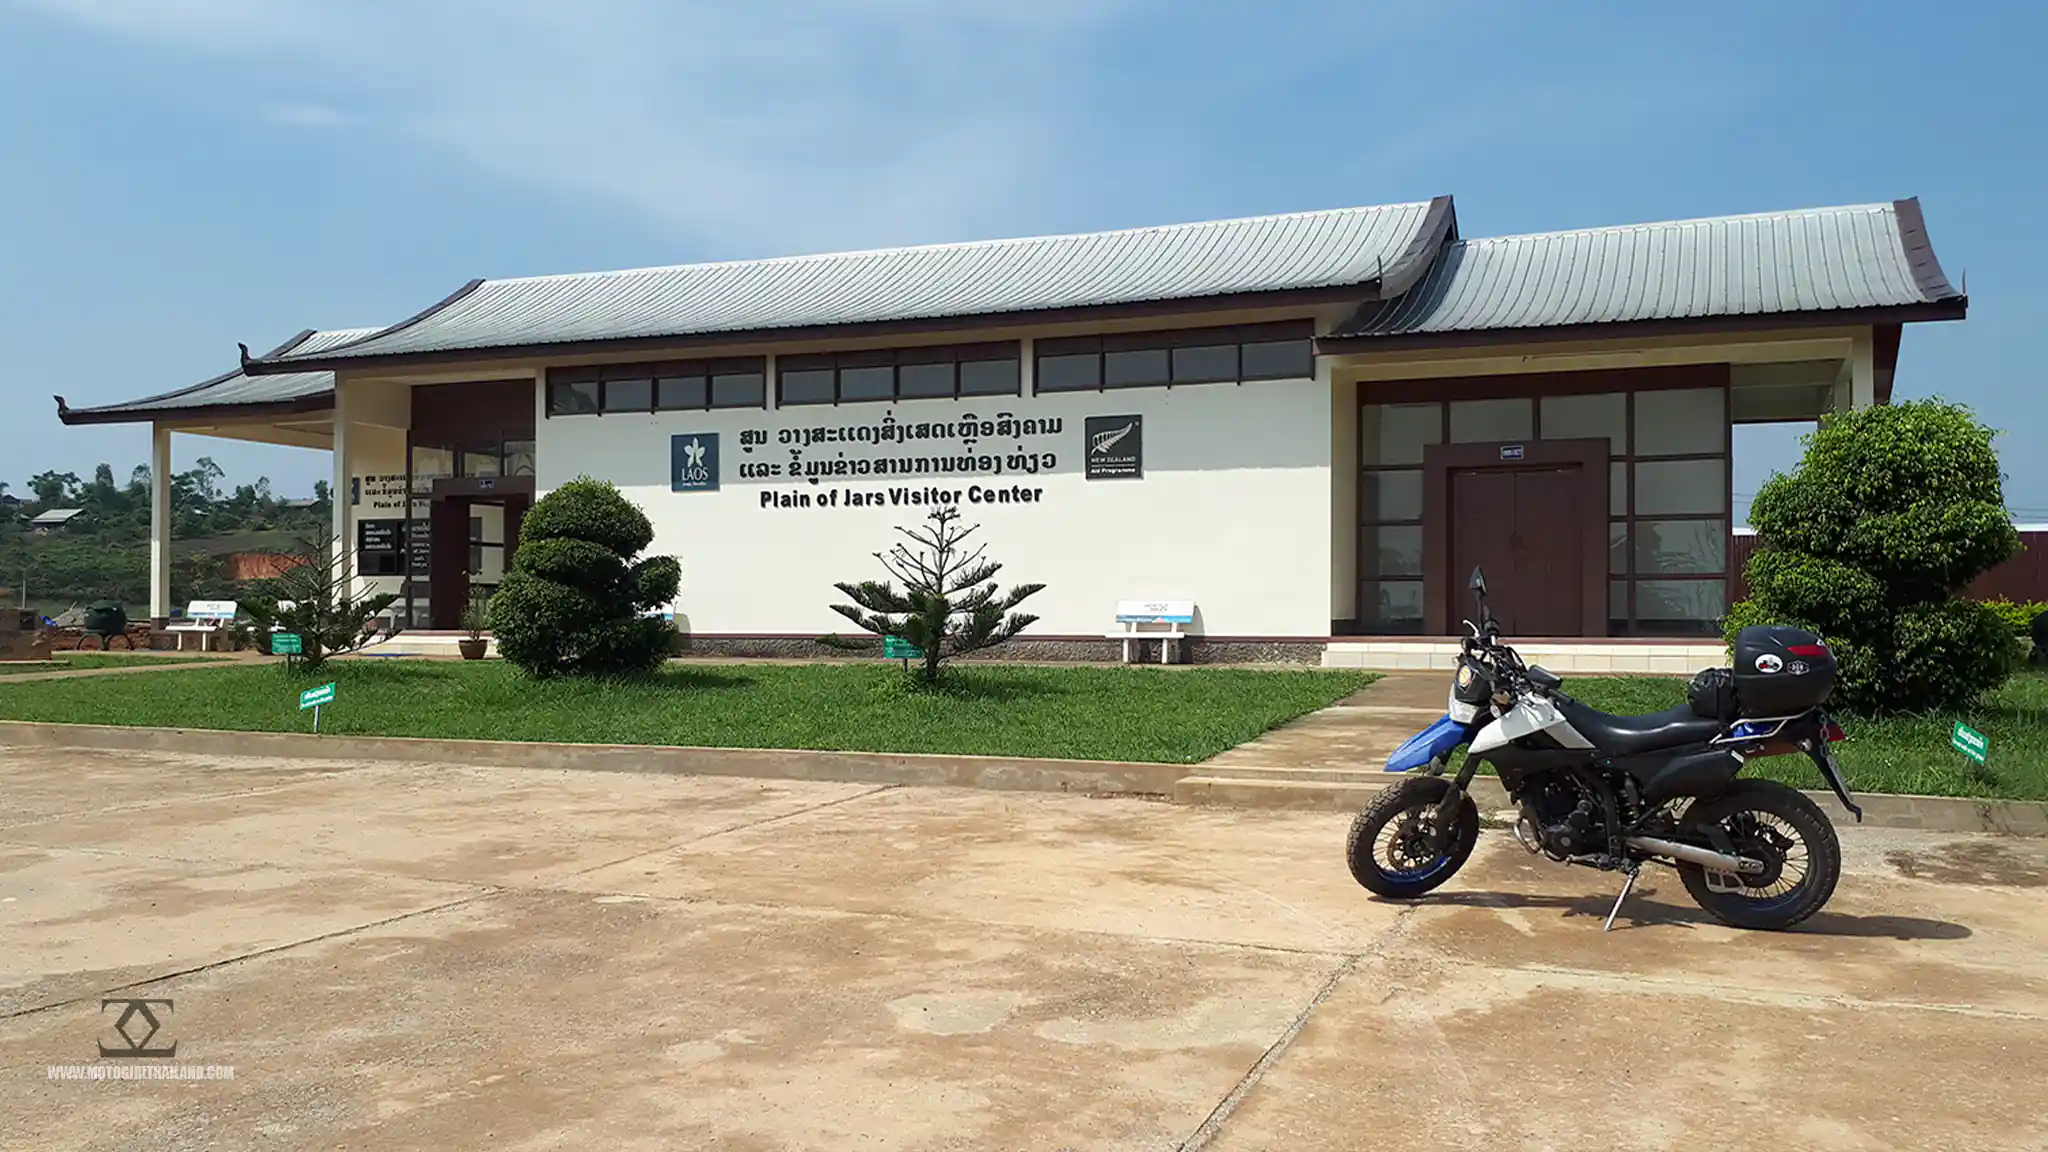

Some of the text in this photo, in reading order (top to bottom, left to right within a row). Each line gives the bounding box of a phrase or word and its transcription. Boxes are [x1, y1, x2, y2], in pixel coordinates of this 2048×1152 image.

[740, 429, 768, 453] ສູນ
[682, 467, 709, 480] LAOS
[760, 485, 1043, 508] Plain of Jars Visitor Center
